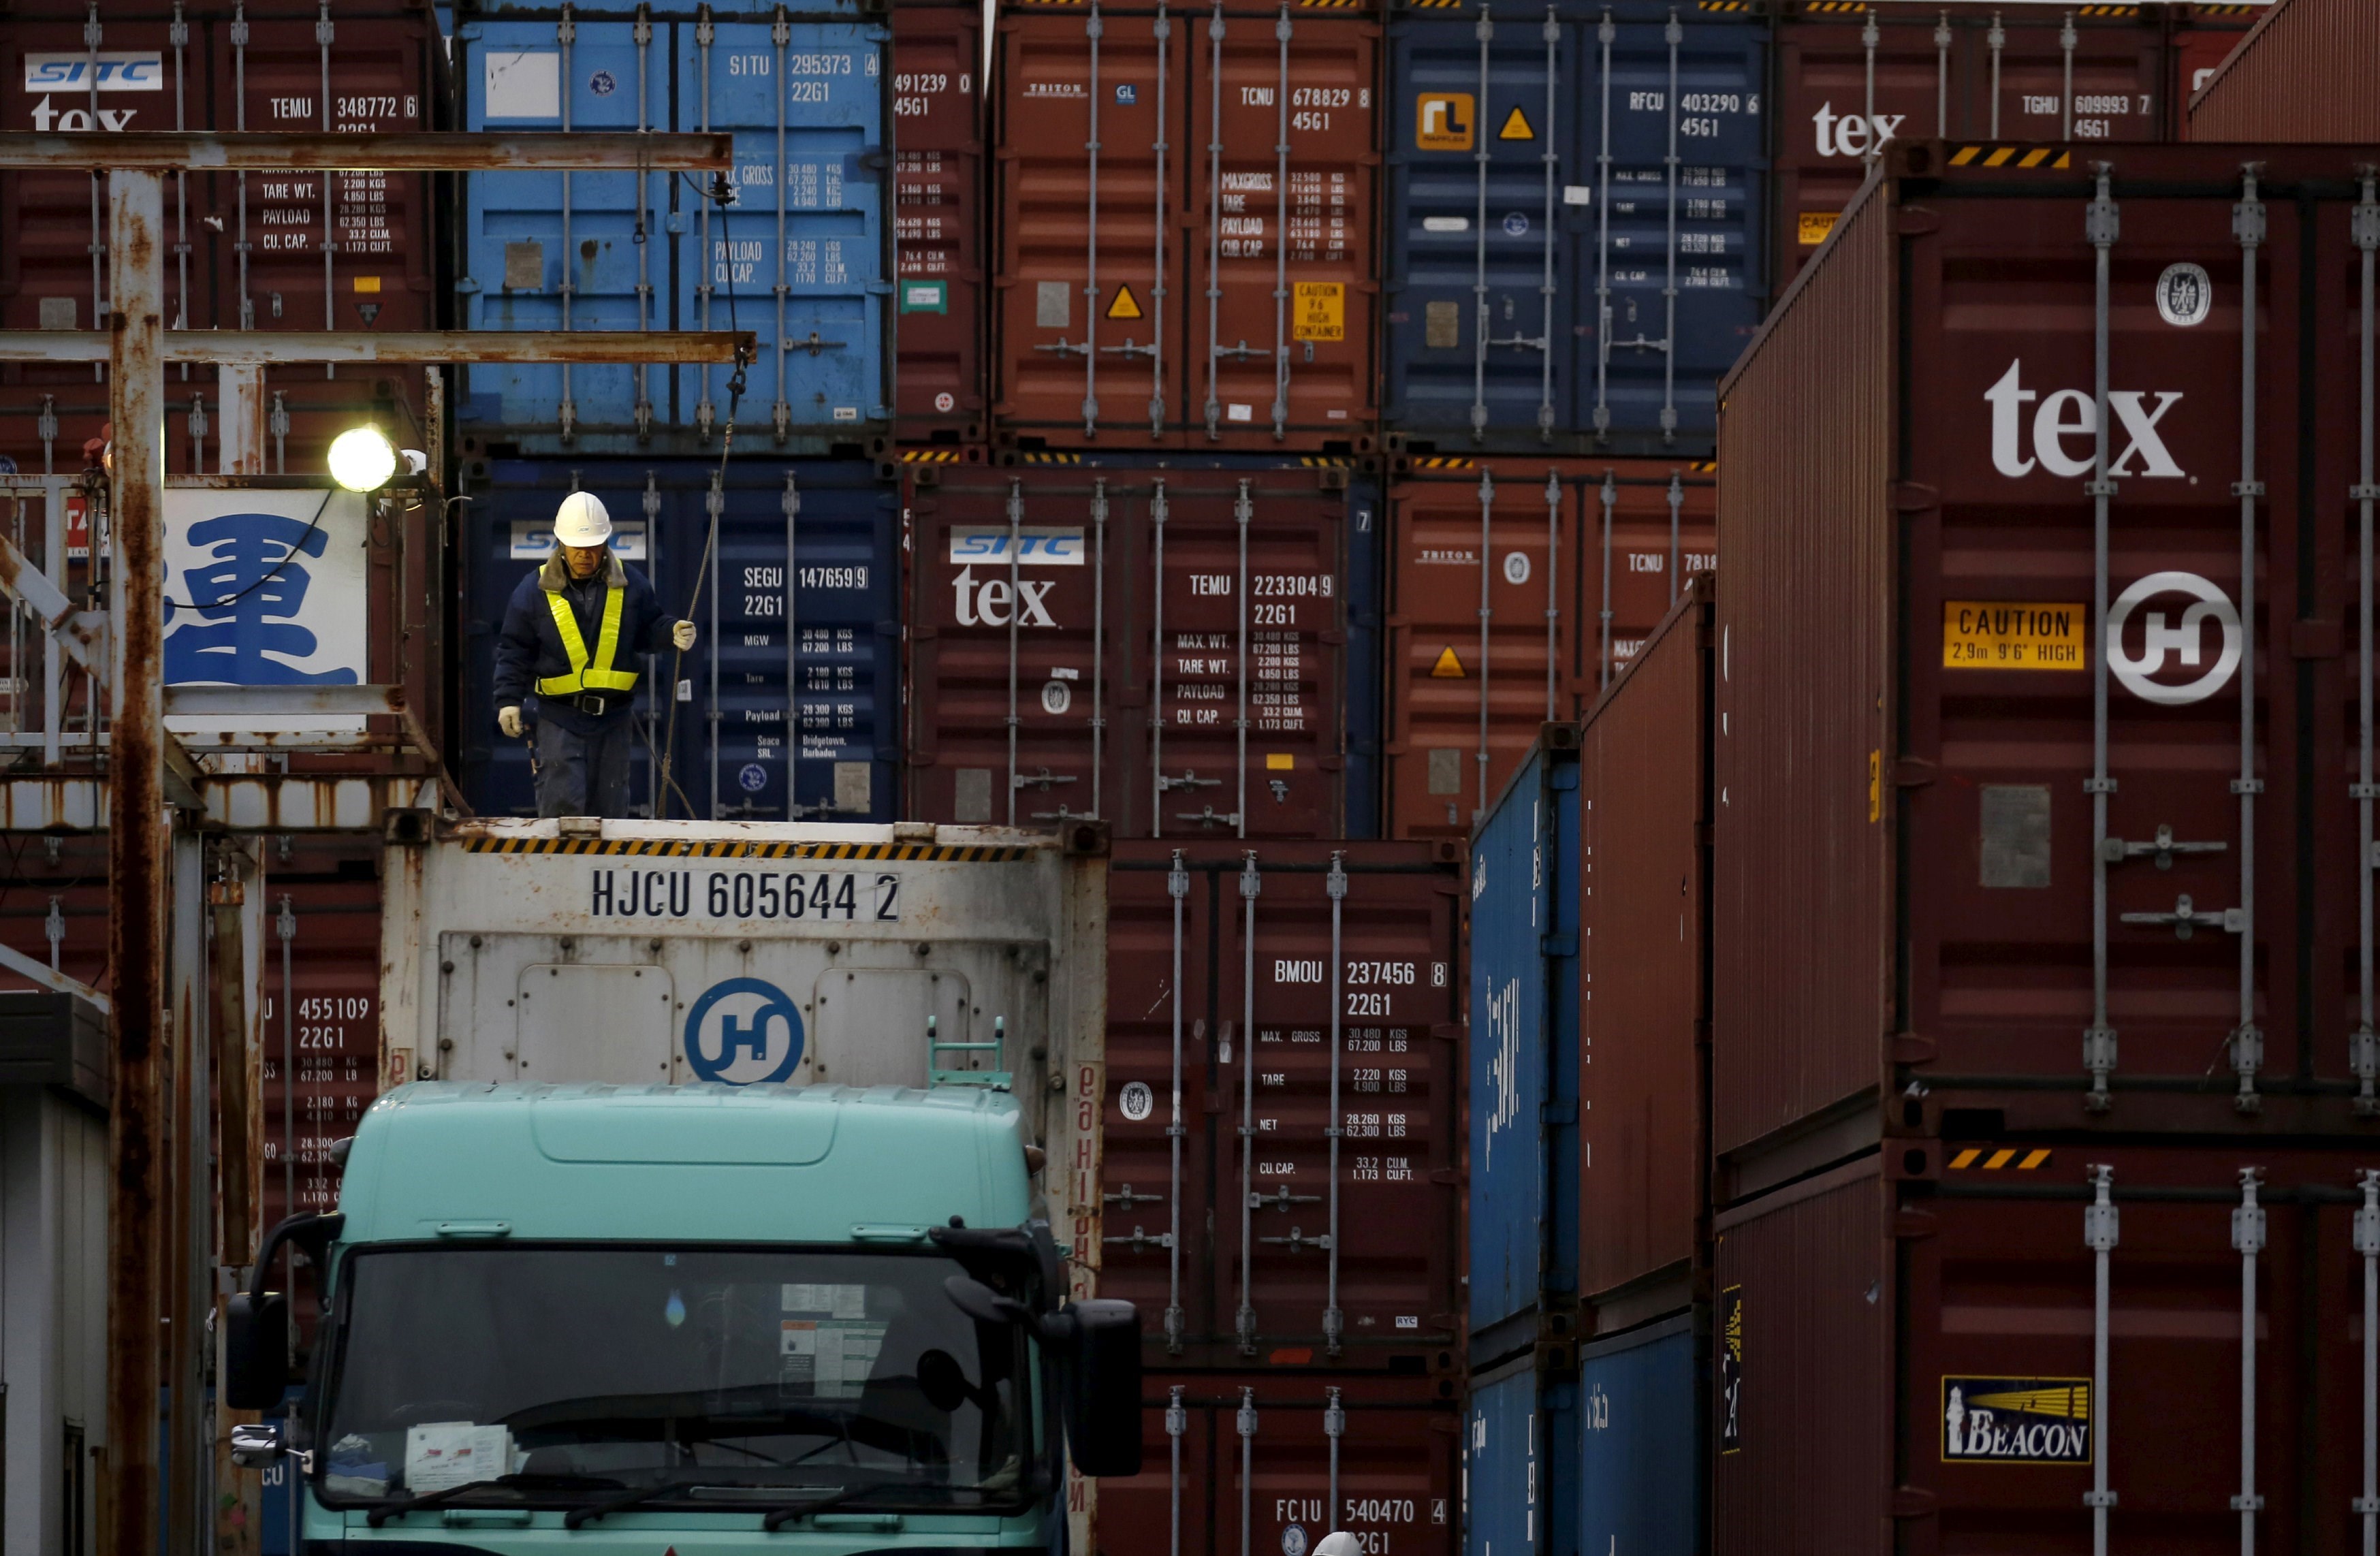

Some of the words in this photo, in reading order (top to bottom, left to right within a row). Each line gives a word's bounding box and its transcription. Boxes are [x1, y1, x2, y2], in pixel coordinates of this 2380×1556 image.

[29, 60, 159, 82] SITC
[730, 56, 769, 76] SITU
[792, 54, 851, 75] 295373
[866, 54, 878, 75] 4
[895, 74, 947, 92] 491239
[1030, 83, 1081, 93] TRITON
[792, 82, 829, 101] 22G1
[1117, 85, 1135, 97] GL
[1241, 87, 1274, 106] TCNU
[1292, 89, 1350, 107] 678829
[272, 98, 312, 118] TEMU
[338, 97, 396, 118] 348772
[405, 96, 417, 117] 6
[894, 97, 928, 116] 45G1
[1630, 93, 1664, 111] RFCU
[1681, 94, 1739, 112] 403290
[2022, 95, 2059, 114] TGHU
[2075, 95, 2128, 114] 609993
[1292, 112, 1329, 131] 45G1
[1681, 118, 1718, 137] 45G1
[2074, 119, 2110, 137] 45G1
[1812, 101, 1905, 157] tex
[743, 165, 773, 185] GROSS
[263, 184, 288, 198] TARE
[295, 184, 315, 198] WT.
[344, 179, 365, 189] 2.200
[370, 179, 385, 189] KGS
[370, 191, 383, 201] LBS
[263, 209, 310, 224] PAYLOAD
[370, 217, 384, 227] LBS
[1222, 218, 1263, 235] PAYLOAD
[349, 230, 366, 238] 33.2
[264, 234, 281, 249] CU.
[285, 234, 308, 249] CAP.
[346, 242, 366, 252] 1.173
[715, 241, 762, 261] PAYLOAD
[1299, 285, 1337, 296] CAUTION
[1295, 325, 1342, 337] CONTAINER
[1984, 358, 2185, 477] tex
[953, 535, 1082, 556] SITC
[1422, 550, 1474, 559] TRITON
[1629, 554, 1663, 572] TCNU
[744, 567, 782, 588] SEGU
[799, 567, 853, 588] 147659
[856, 567, 867, 588] 9
[1190, 575, 1231, 595] TEMU
[1254, 576, 1317, 595] 223304
[1322, 576, 1332, 596] 9
[952, 563, 1057, 626] tex
[744, 595, 782, 616] 22G1
[1254, 605, 1295, 624] 22G1
[1959, 609, 2069, 637] CAUTION
[744, 635, 769, 646] MGW
[837, 630, 853, 639] KGS
[1177, 634, 1206, 648] MAX.
[838, 642, 853, 652] LBS
[1283, 644, 1299, 654] LBS
[2037, 644, 2076, 661] HIGH
[1177, 659, 1204, 673] TARE
[1209, 659, 1230, 673] WT.
[1258, 657, 1280, 666] 2.200
[1283, 657, 1299, 666] KGS
[838, 667, 853, 676] KGS
[1283, 669, 1299, 679] LBS
[1177, 684, 1224, 699] PAYLOAD
[1283, 694, 1299, 704] LBS
[838, 704, 853, 714] KGS
[1263, 707, 1280, 716] 33.2
[746, 710, 780, 723] Payload
[1177, 710, 1192, 724] CU.
[1196, 710, 1220, 724] CAP.
[1259, 720, 1280, 729] 1.173
[758, 735, 779, 746] Seaco
[803, 748, 836, 758] Barbados
[592, 870, 691, 917] HJCU
[708, 872, 857, 919] 605644
[876, 874, 899, 921] 2
[1275, 960, 1322, 983] BMOU
[1348, 962, 1414, 984] 237456
[1433, 962, 1445, 985] 8
[299, 998, 368, 1019] 455109
[1347, 994, 1391, 1015] 22G1
[300, 1027, 343, 1049] 22G1
[1261, 1031, 1283, 1042] MAX.
[1292, 1031, 1320, 1042] GROSS
[1389, 1029, 1407, 1038] KGS
[1348, 1041, 1380, 1051] 67.200
[1389, 1041, 1407, 1051] LBS
[346, 1070, 357, 1081] LB
[1262, 1074, 1284, 1085] TARE
[1354, 1069, 1380, 1080] 2.220
[1389, 1069, 1406, 1080] KGS
[1354, 1081, 1380, 1092] 4.900
[1389, 1081, 1406, 1092] LBS
[346, 1096, 358, 1107] KG
[1260, 1119, 1278, 1130] NET
[1347, 1114, 1379, 1124] 28.260
[1388, 1114, 1406, 1124] KGS
[1347, 1126, 1379, 1137] 62.300
[1388, 1126, 1406, 1137] LBS
[1356, 1158, 1378, 1169] 33.2
[1352, 1170, 1378, 1180] 1.173
[1397, 1317, 1416, 1325] RYC
[1276, 1499, 1321, 1522] FCIU
[1346, 1499, 1414, 1522] 540470
[1433, 1499, 1444, 1522] 4
